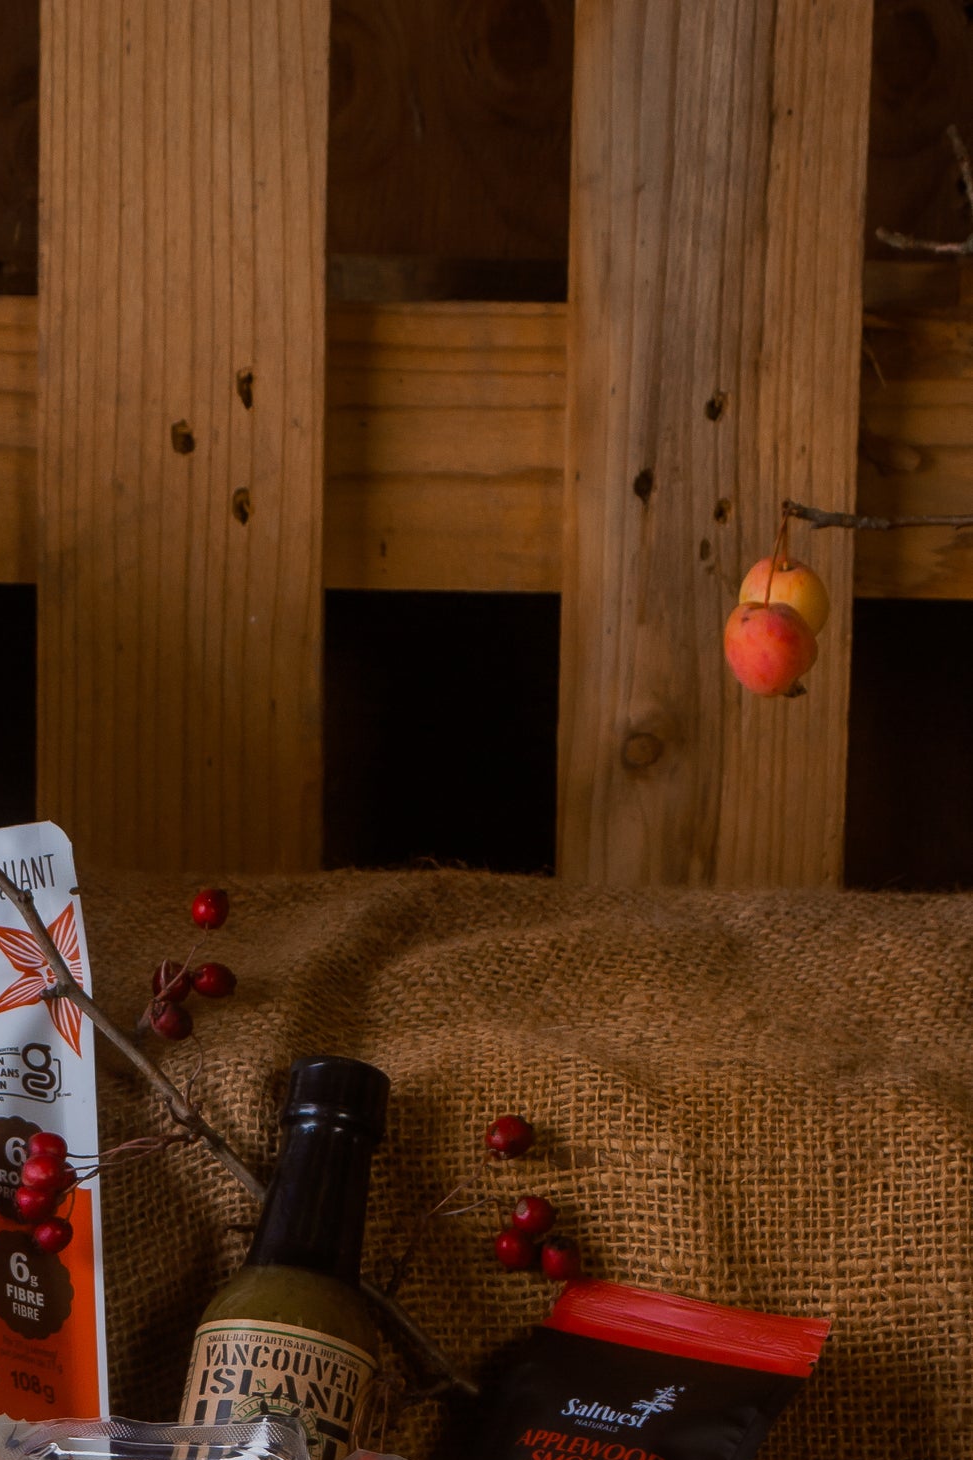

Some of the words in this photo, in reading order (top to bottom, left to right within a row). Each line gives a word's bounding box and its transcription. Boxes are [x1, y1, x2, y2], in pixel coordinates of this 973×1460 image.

[6, 1283, 45, 1307] FIBRE
[12, 1301, 41, 1321] FIBRE
[264, 1335, 318, 1355] ARTISANAL
[206, 1343, 360, 1397] VANCOUVER
[199, 1367, 355, 1422] ISLAND
[574, 1418, 620, 1433] NATURALS
